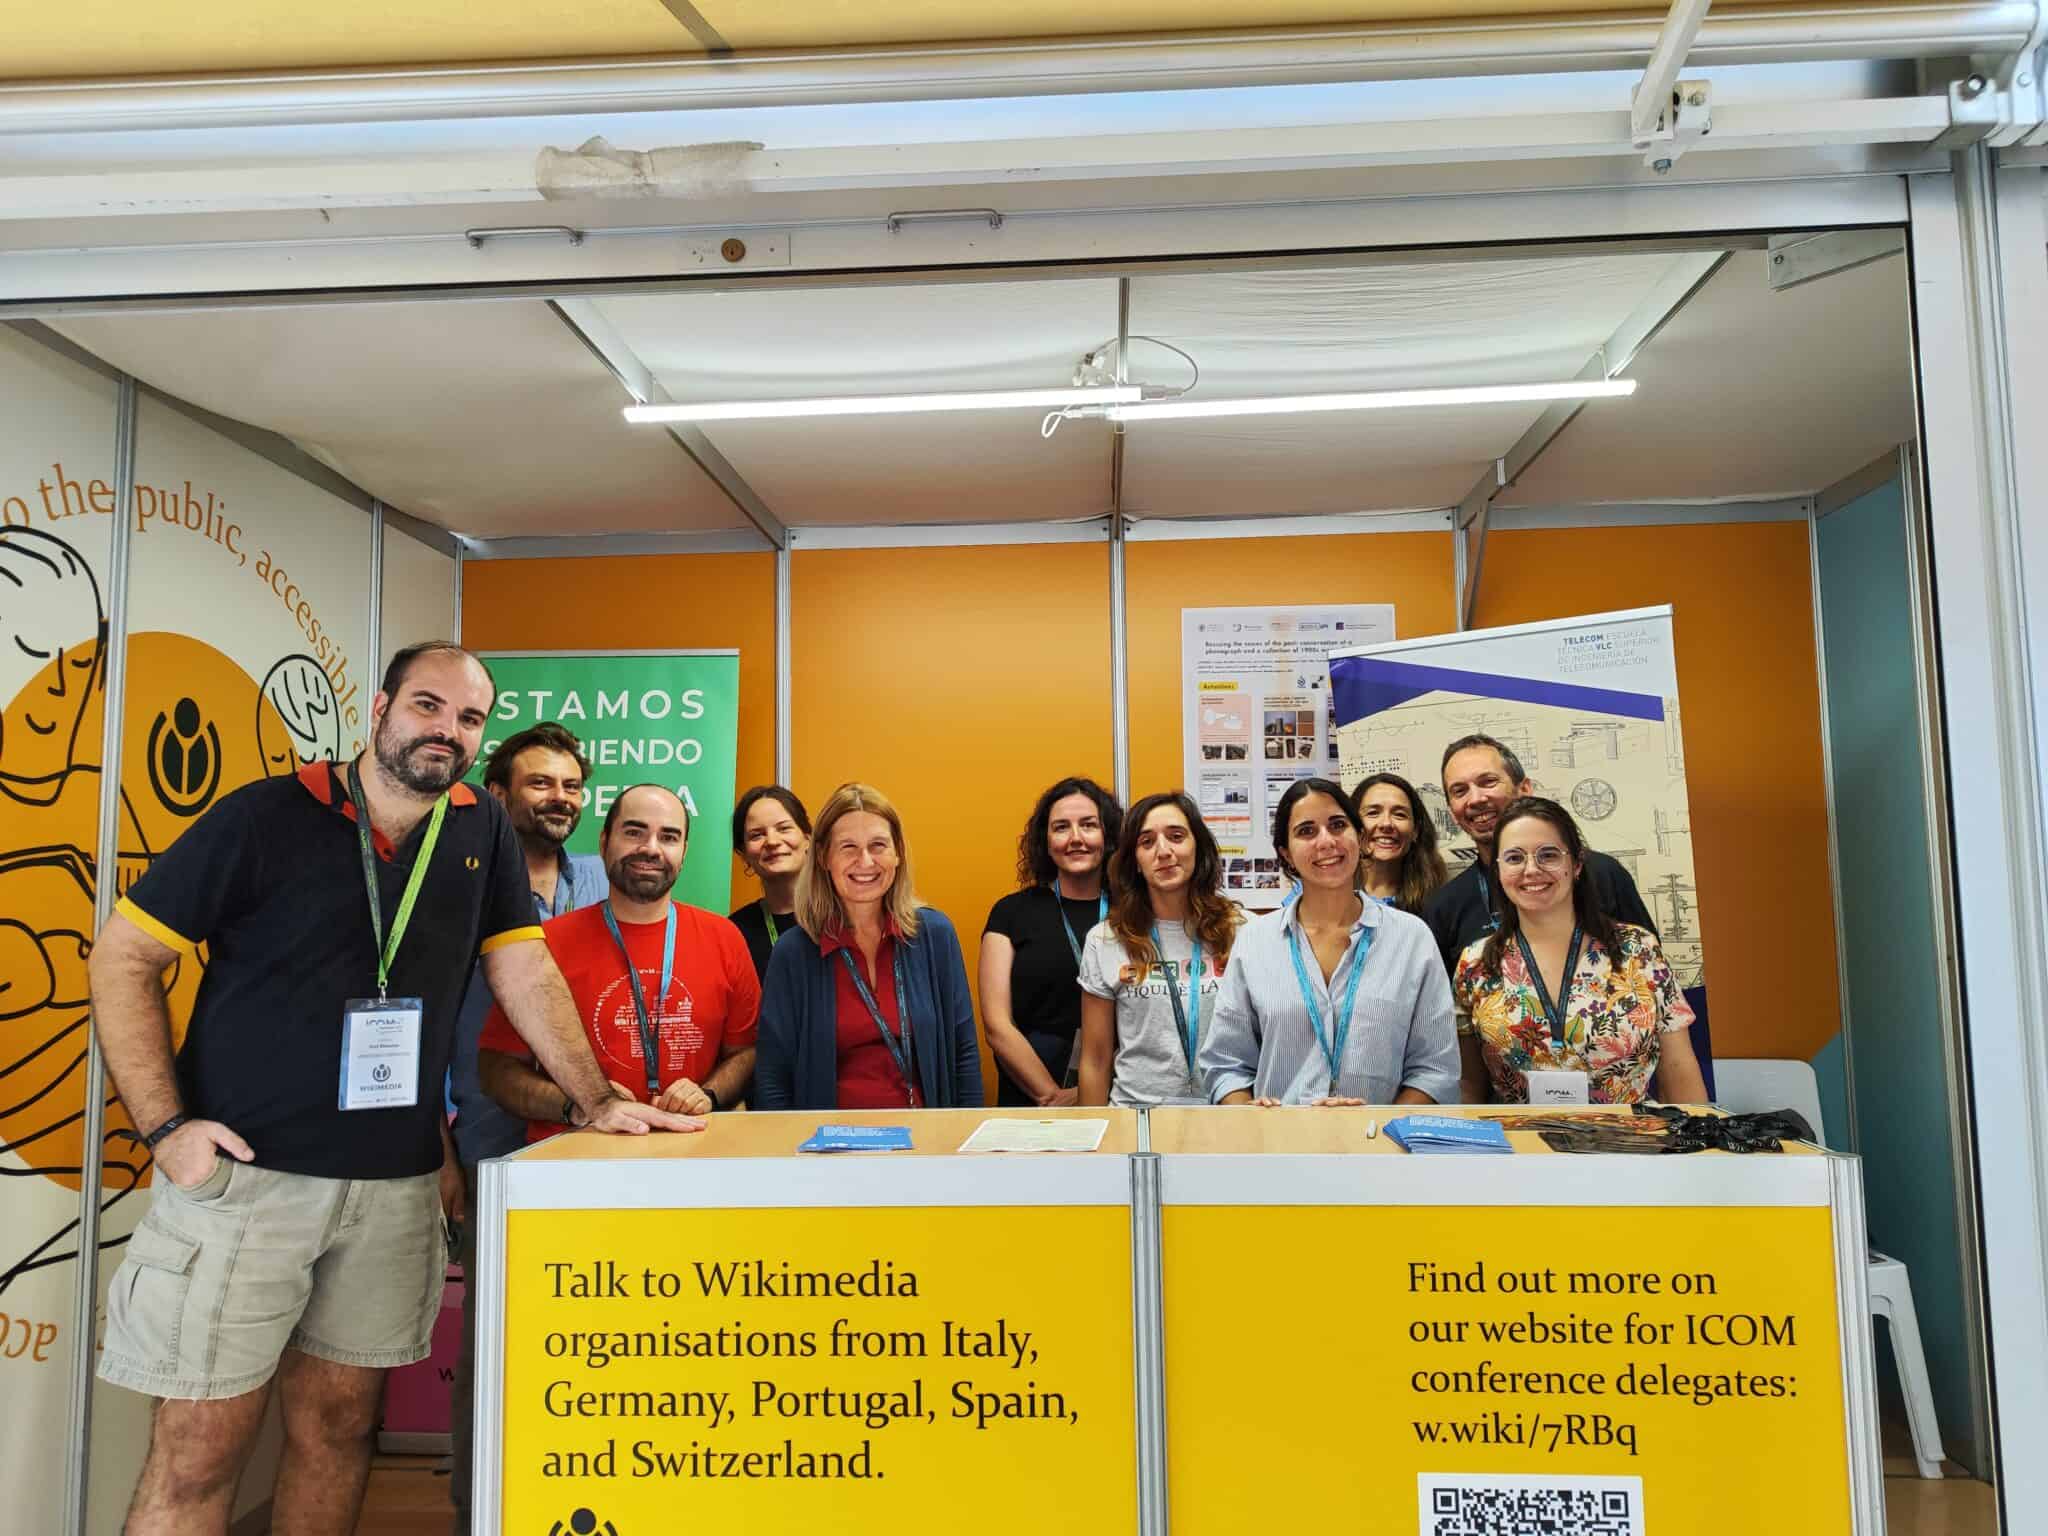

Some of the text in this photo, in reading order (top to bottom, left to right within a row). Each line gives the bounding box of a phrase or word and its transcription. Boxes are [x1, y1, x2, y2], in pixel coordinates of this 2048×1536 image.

[37, 463, 115, 520] the
[134, 480, 246, 568] public,
[256, 550, 359, 731] accessible
[1563, 633, 1604, 646] TELECOM
[1595, 641, 1613, 651] VLC
[497, 689, 705, 720] STAMOS
[545, 1260, 919, 1298] Talk to Wikimedia
[1408, 1261, 1718, 1295] Find out more on
[544, 1319, 1039, 1369] organisations from Italy,
[1409, 1312, 1797, 1346] our website for ICOM
[1411, 1361, 1797, 1405] conference delegates:
[544, 1380, 1079, 1430] Germany, Portugal, Spain,
[1412, 1412, 1638, 1456] w.wiki/7RBq
[542, 1440, 884, 1479] and Switzerland.
